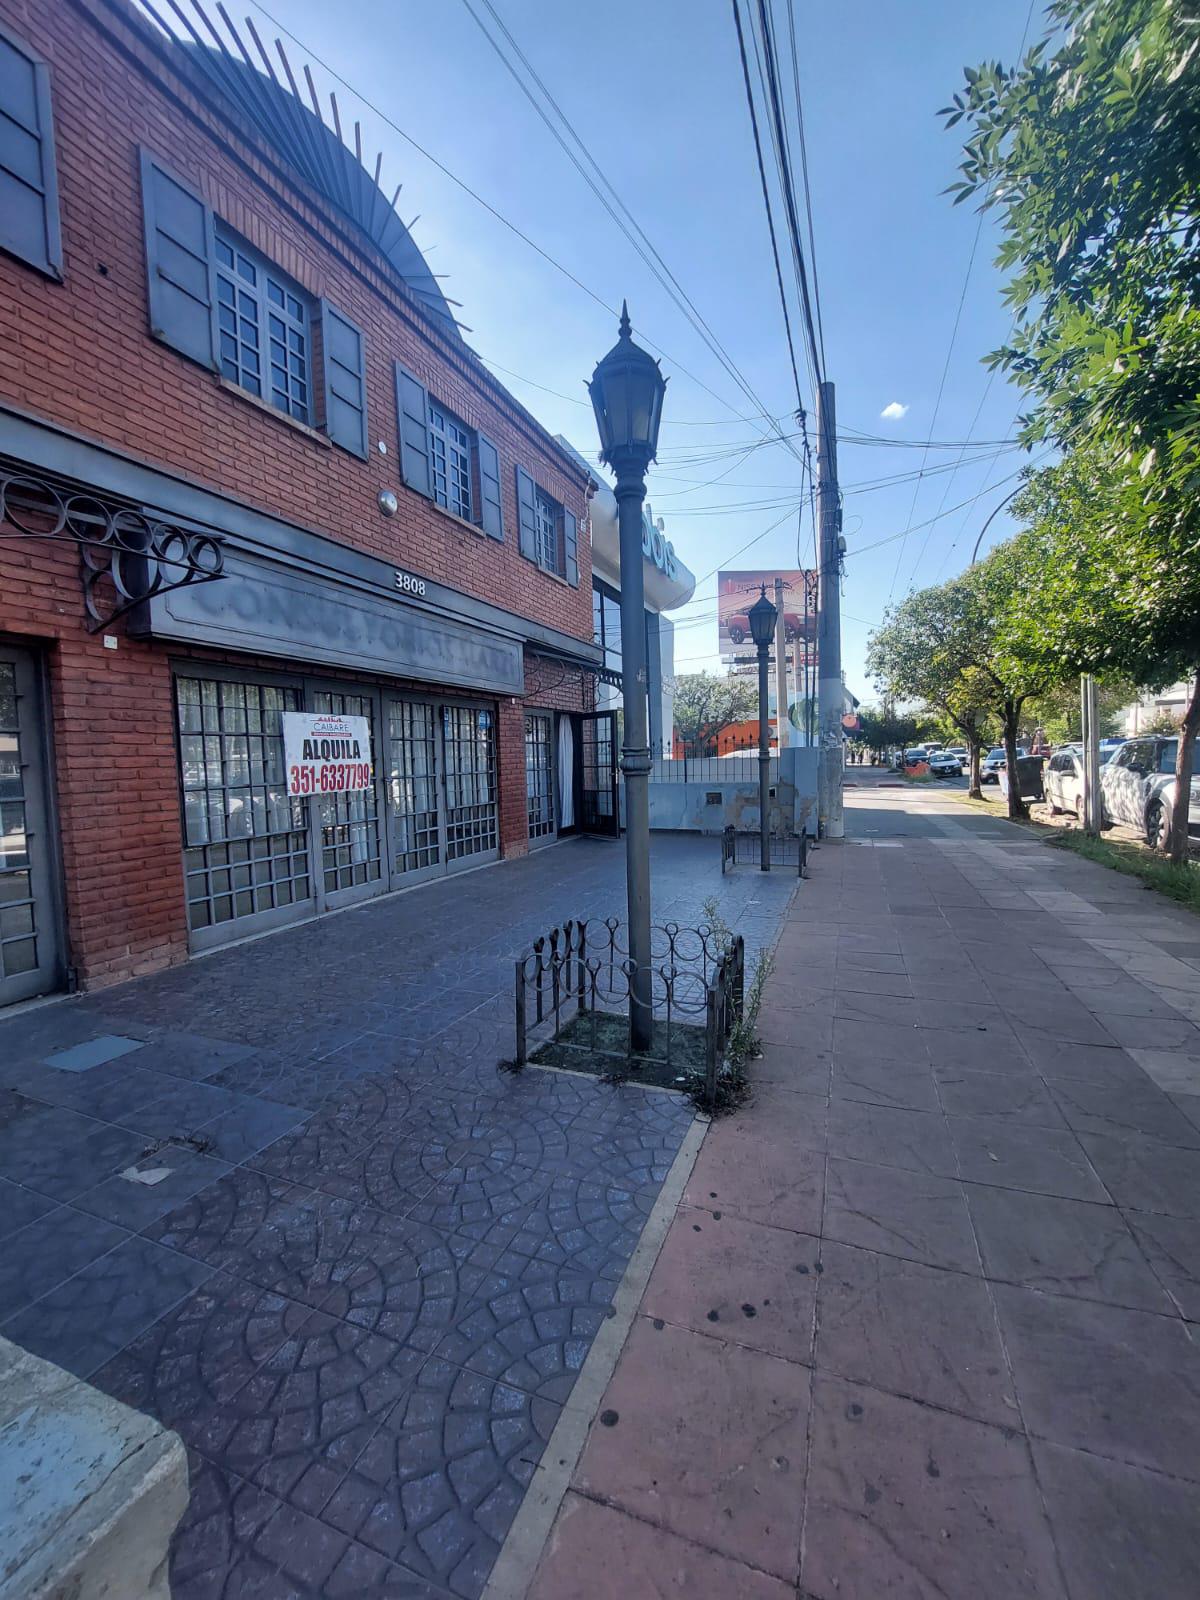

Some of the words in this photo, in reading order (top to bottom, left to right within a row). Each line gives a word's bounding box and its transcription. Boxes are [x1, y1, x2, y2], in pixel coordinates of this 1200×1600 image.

[394, 571, 426, 596] 3808
[302, 738, 361, 762] ALQUILA
[290, 762, 370, 795] 351-6337799
